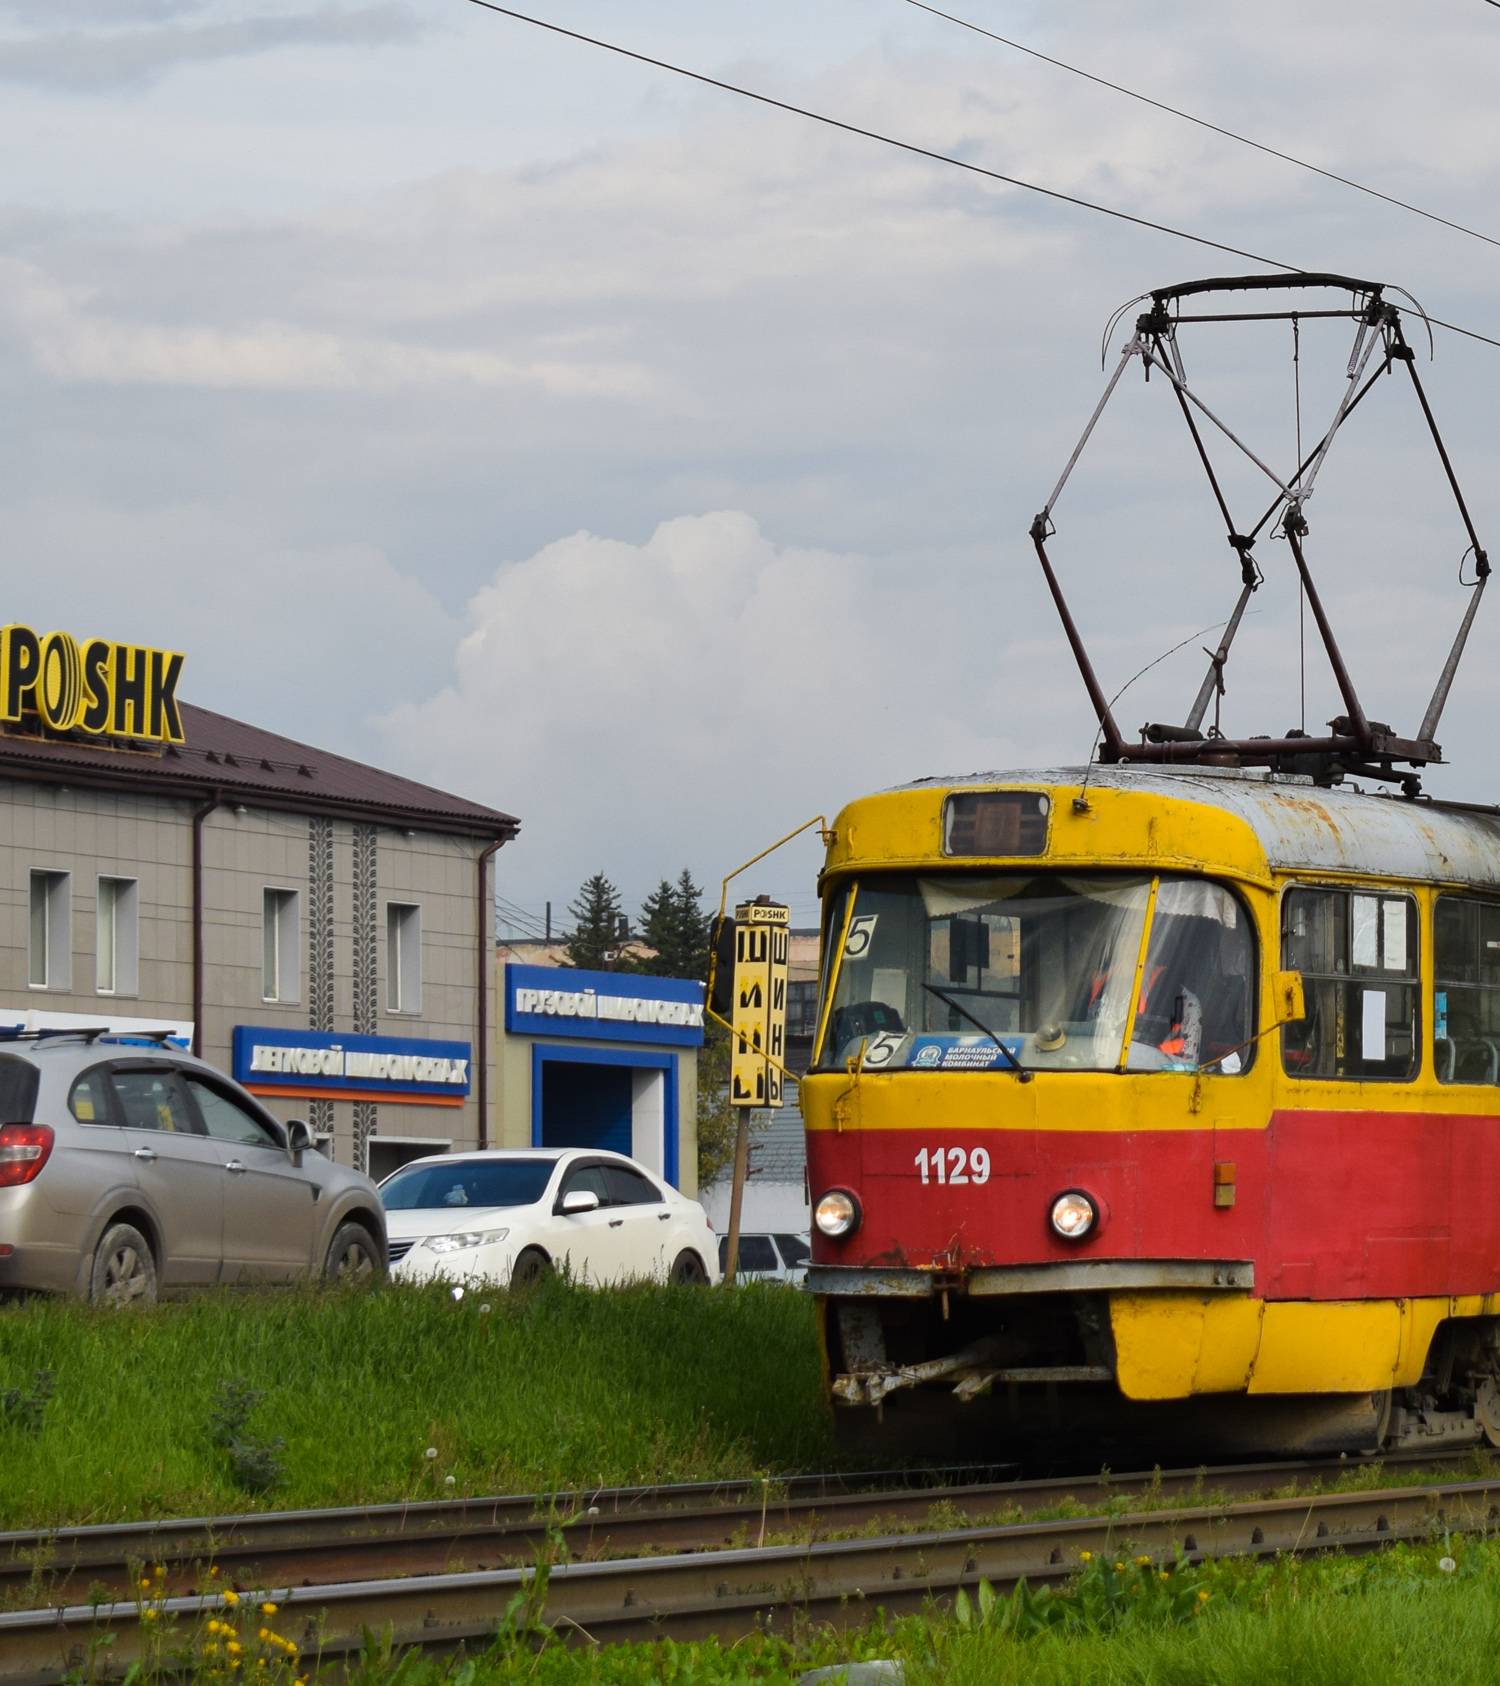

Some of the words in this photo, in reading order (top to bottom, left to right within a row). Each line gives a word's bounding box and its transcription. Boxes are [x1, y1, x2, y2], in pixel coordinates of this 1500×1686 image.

[1, 624, 186, 744] POSHK
[753, 908, 786, 920] POSHK
[845, 915, 874, 956] 5
[516, 987, 596, 1018] ГРУЗОВОЙ
[768, 930, 788, 1102] ШИНЫ
[250, 1044, 344, 1076] ЛЕГКОВОЙ
[864, 1033, 907, 1065] 5
[941, 1060, 990, 1068] КОМБИНАТ
[944, 1053, 998, 1061] МОЛОЧНЫЙ
[914, 1147, 991, 1185] 1129
